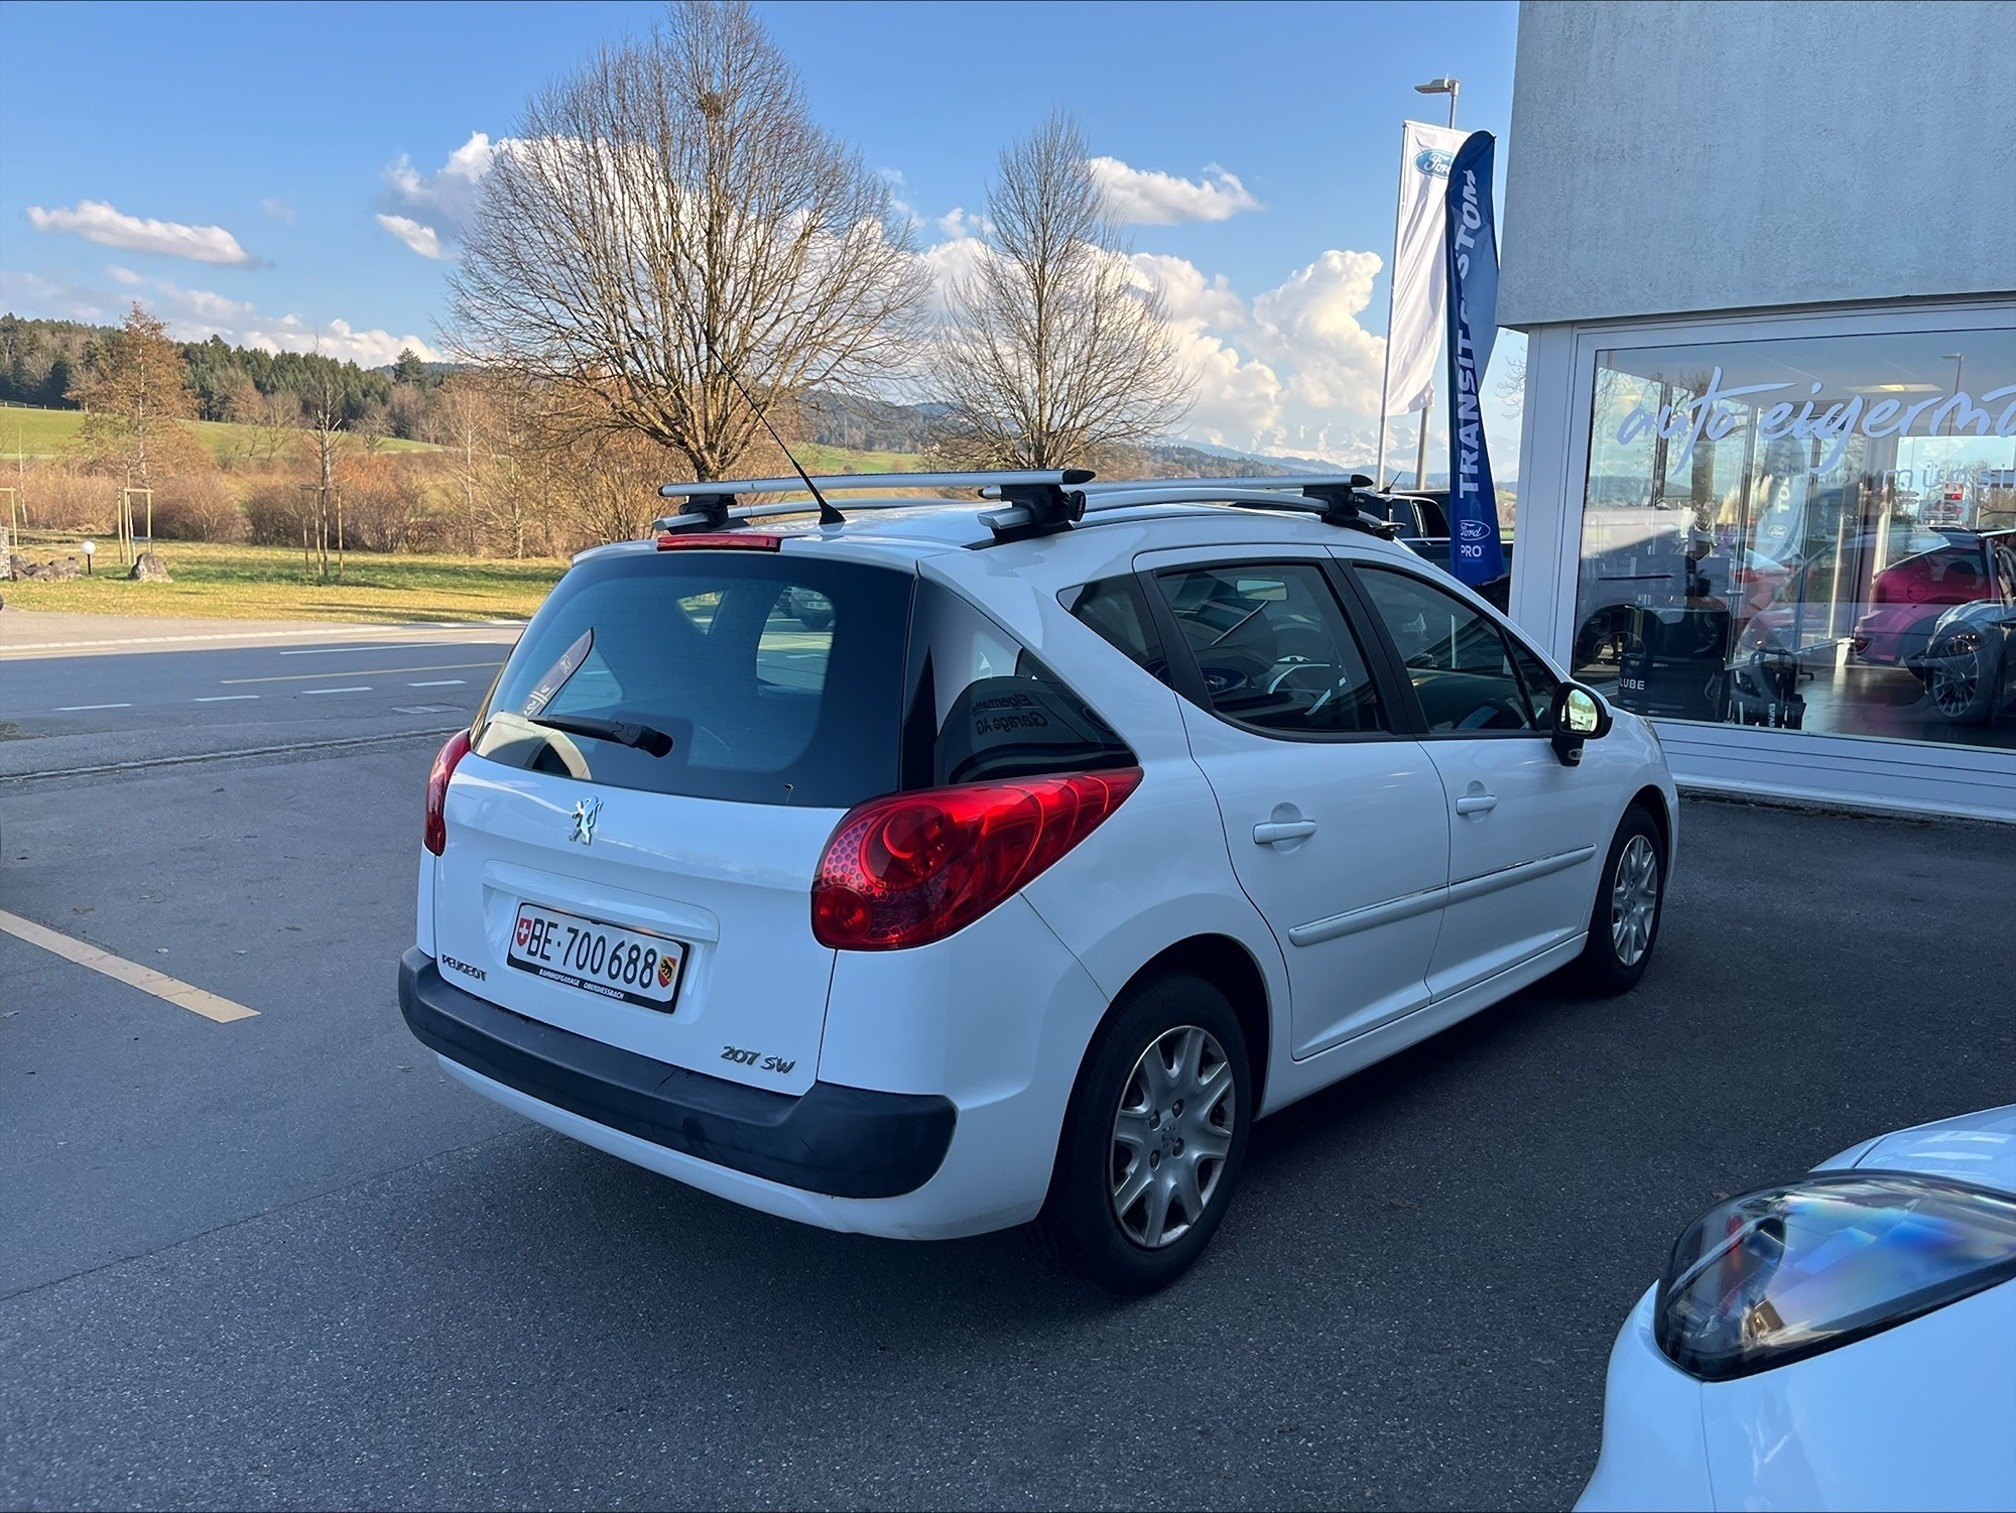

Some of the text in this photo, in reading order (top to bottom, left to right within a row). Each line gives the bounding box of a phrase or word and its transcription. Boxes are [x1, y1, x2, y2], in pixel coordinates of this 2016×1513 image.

[1457, 330, 1480, 499] TRANSIT
[1616, 366, 1798, 477] auto
[1882, 463, 2016, 489] münsi
[1460, 544, 1482, 557] PRO
[442, 953, 487, 982] PEUGEOT
[721, 1045, 796, 1074] 207 SW
